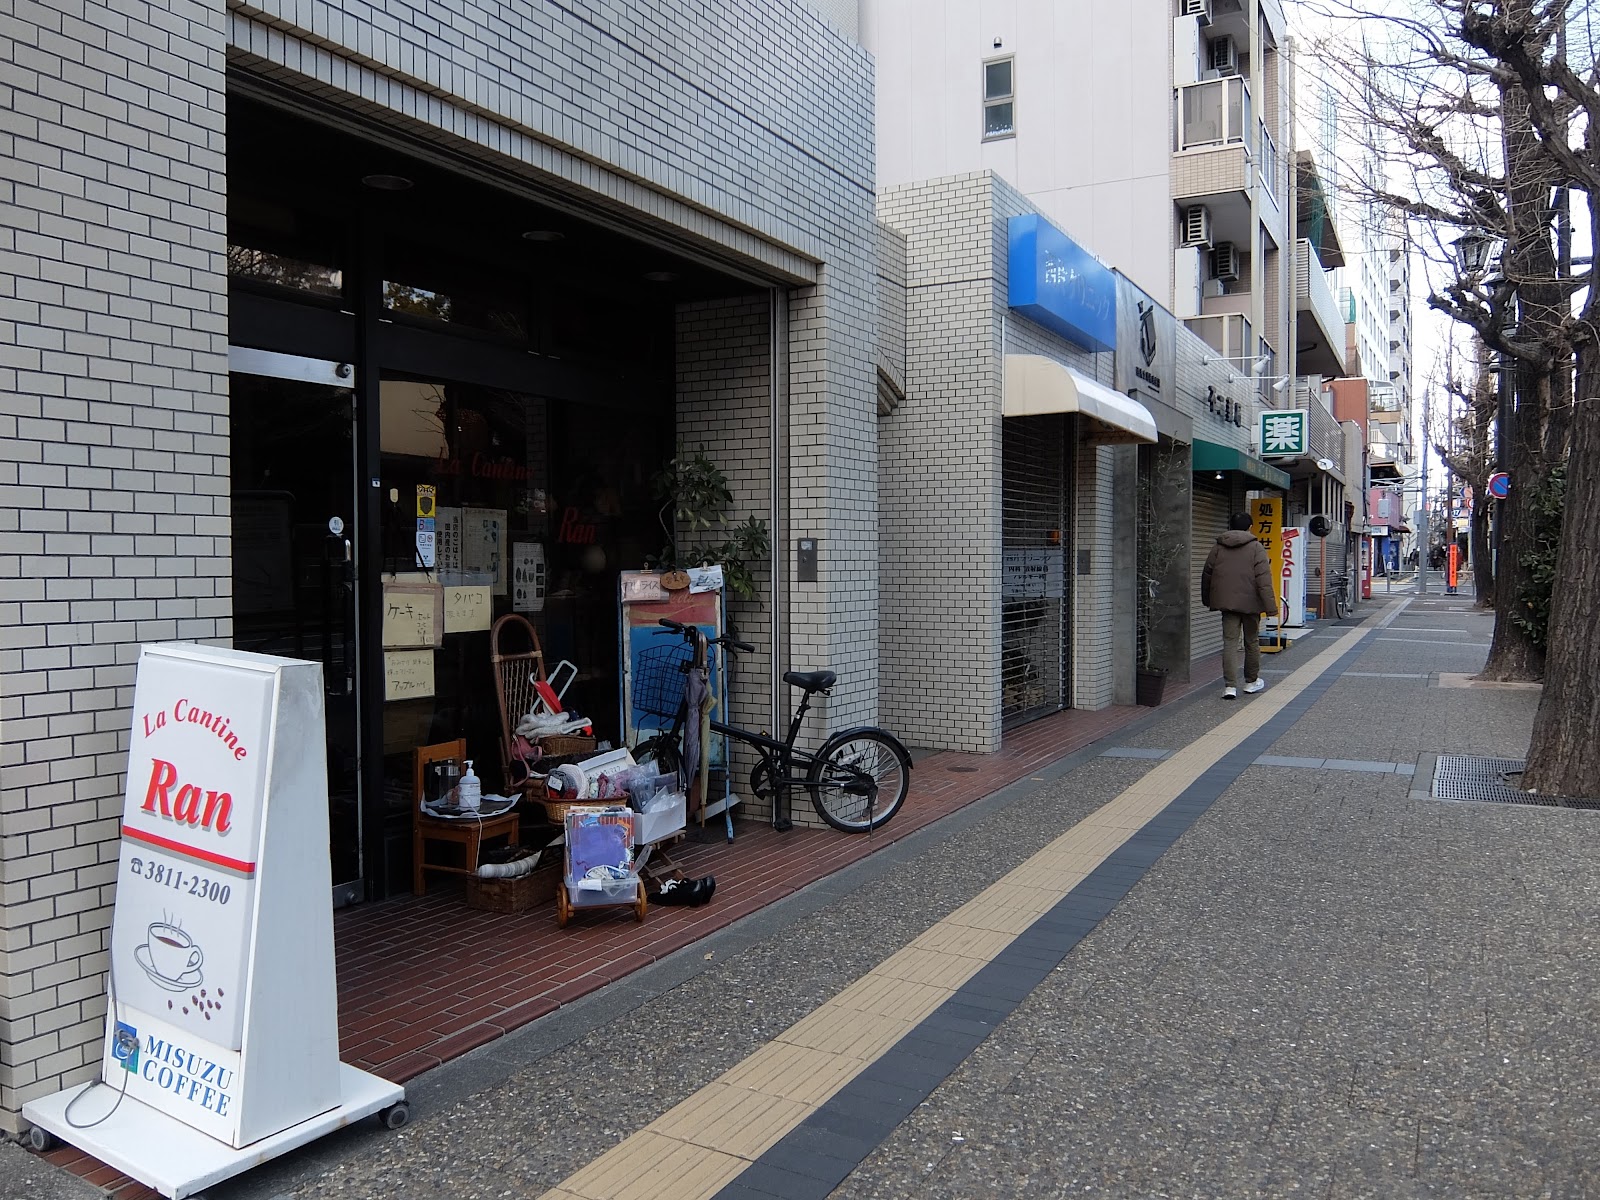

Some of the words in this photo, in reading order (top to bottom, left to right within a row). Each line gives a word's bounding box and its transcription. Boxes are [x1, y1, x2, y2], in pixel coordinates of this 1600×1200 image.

[1264, 416, 1300, 451] 薬
[559, 506, 596, 544] Ran
[1259, 503, 1273, 565] 処方せ
[1282, 540, 1295, 578] DyDo
[454, 592, 483, 605] タバコ
[623, 580, 660, 593] カライス
[387, 602, 413, 620] ケーキ
[143, 711, 167, 739] La
[173, 697, 248, 762] Cantine
[140, 756, 233, 835] Ran
[144, 860, 231, 906] 3811-2300
[144, 1034, 234, 1090] MISUZU
[143, 1059, 231, 1118] COFFEE
